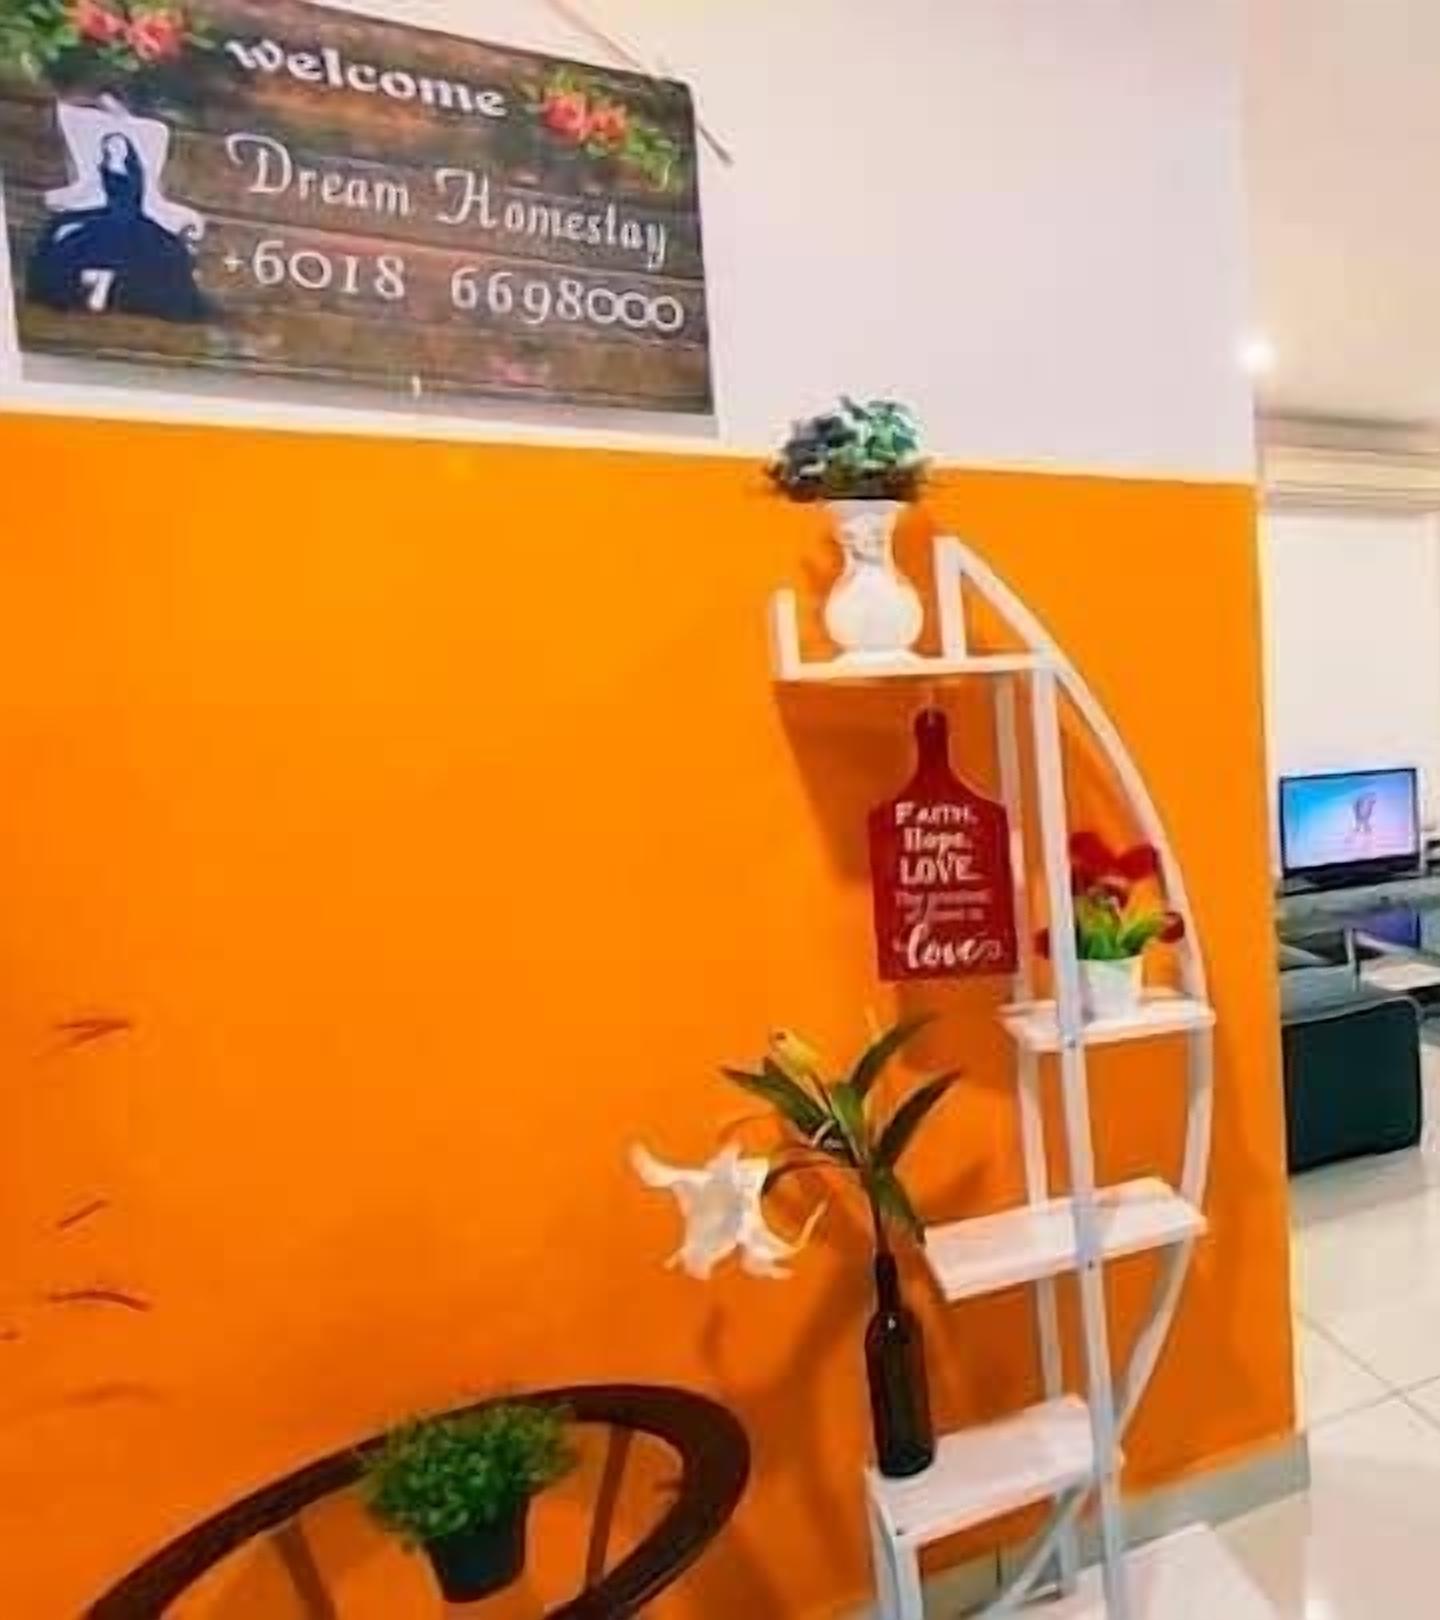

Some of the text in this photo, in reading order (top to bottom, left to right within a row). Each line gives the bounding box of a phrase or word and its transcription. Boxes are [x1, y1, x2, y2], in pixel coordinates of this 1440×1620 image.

[224, 38, 507, 117] welcome
[225, 132, 666, 270] Dream Homestay
[223, 240, 684, 332] +6018 6698000
[900, 853, 983, 885] LOVE
